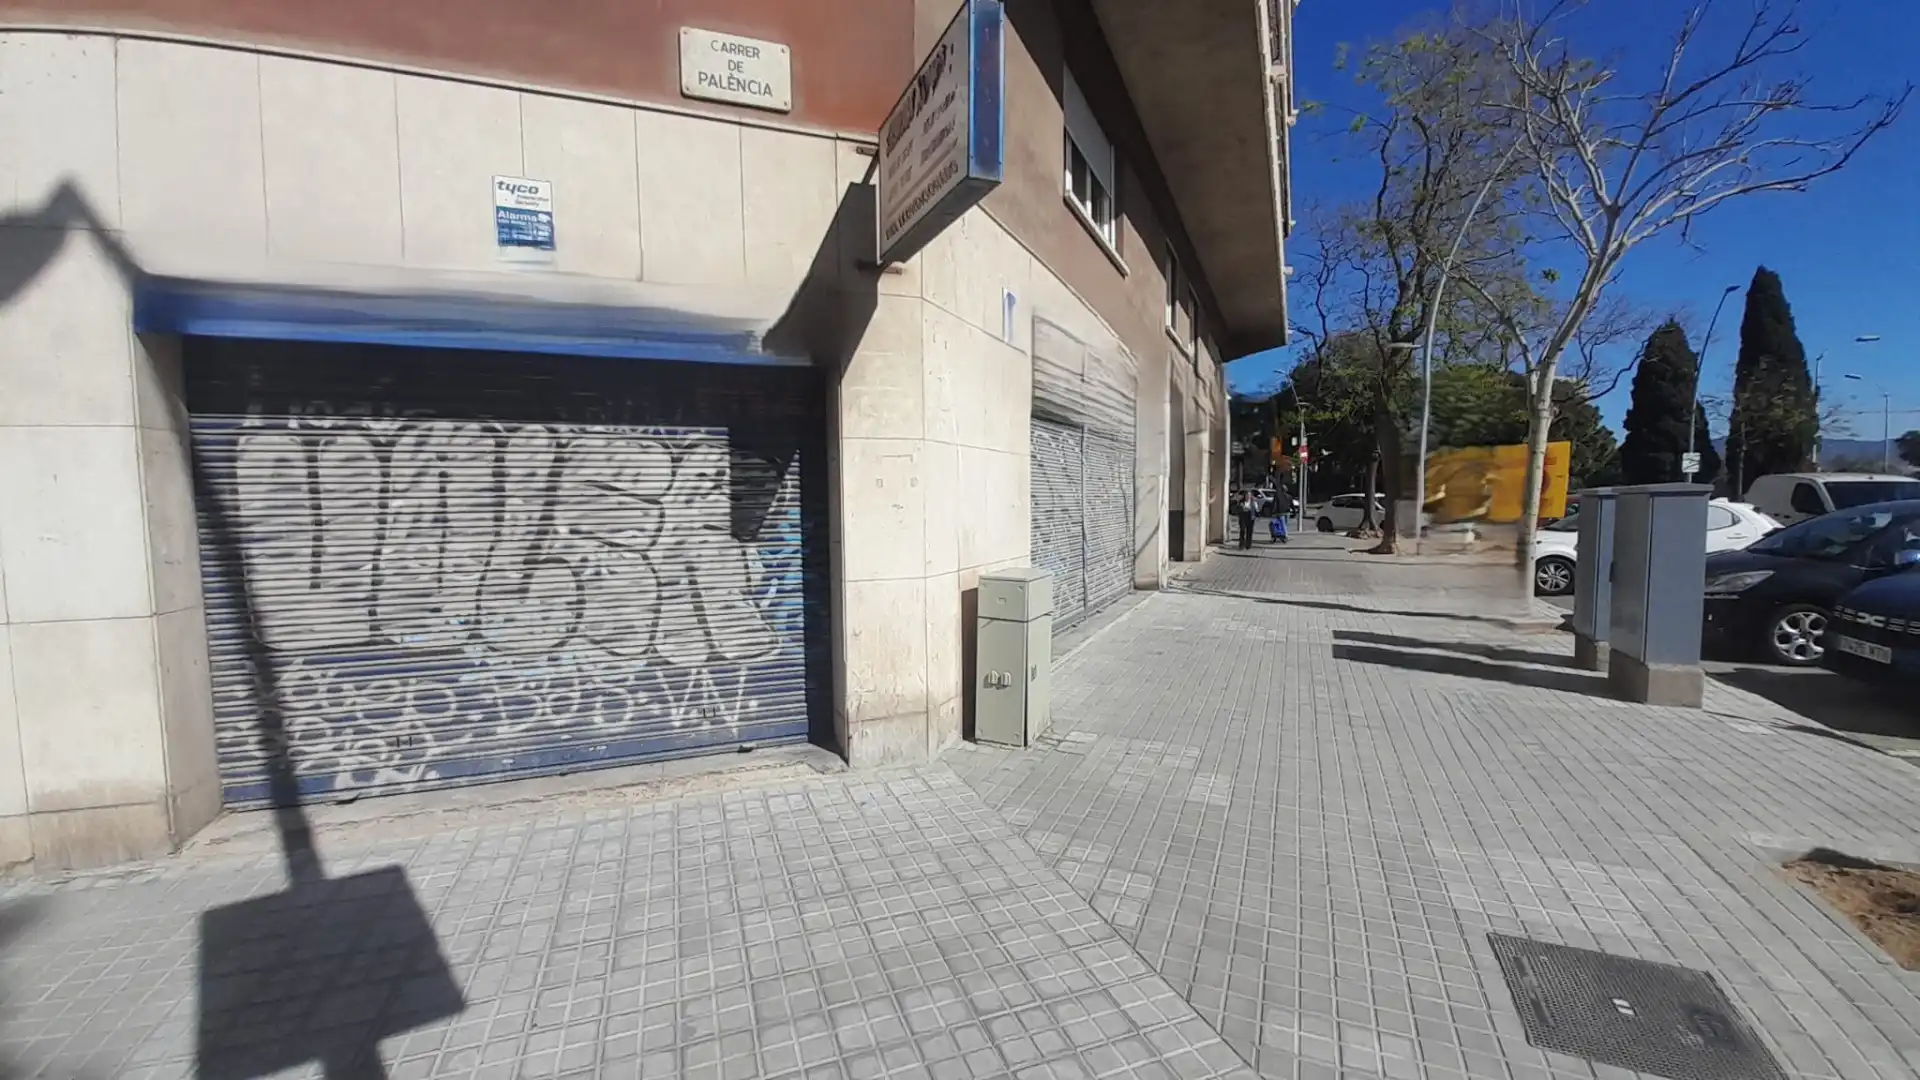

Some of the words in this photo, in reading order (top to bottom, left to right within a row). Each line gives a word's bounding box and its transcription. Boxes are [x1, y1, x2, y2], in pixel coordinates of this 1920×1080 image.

[710, 40, 760, 59] CARRER
[728, 59, 744, 73] DE
[698, 71, 773, 97] PALÈNCIA
[496, 181, 539, 194] tyco
